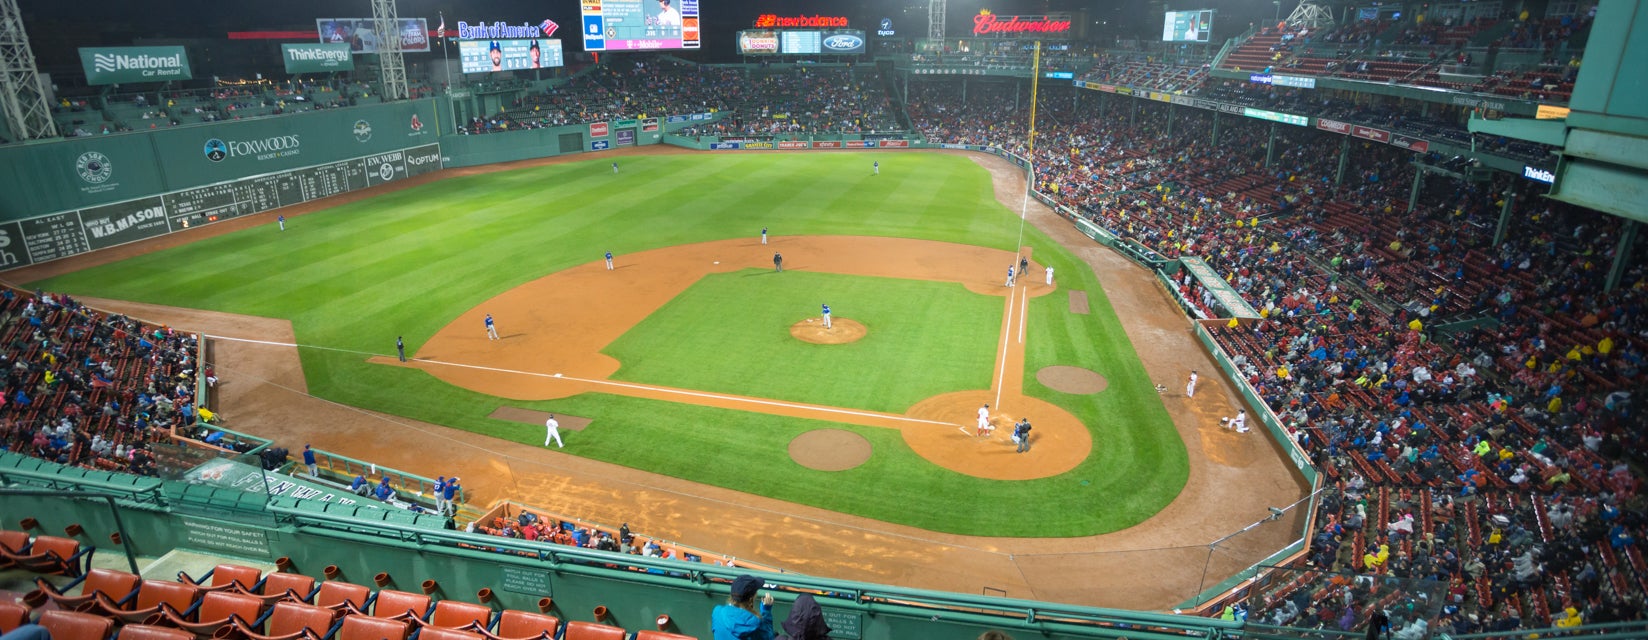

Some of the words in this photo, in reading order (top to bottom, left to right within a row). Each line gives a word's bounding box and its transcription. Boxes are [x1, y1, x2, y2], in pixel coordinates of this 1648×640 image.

[458, 21, 489, 38] Bank
[491, 22, 500, 38] of
[501, 22, 540, 38] America
[974, 14, 1070, 34] Budweiser
[831, 37, 855, 49] Ford
[288, 48, 349, 60] ThinkEnergy
[116, 54, 180, 69] National
[229, 135, 300, 157] FOXWOODS
[382, 153, 403, 163] WEBB
[415, 154, 439, 165] OPTUM
[81, 163, 111, 182] SCHOLARS
[1524, 166, 1555, 183] ThinkEn
[181, 188, 211, 197] FENWAY
[86, 219, 99, 228] WHO
[91, 206, 164, 238] W.B.MASON
[138, 222, 153, 230] SINCE
[183, 220, 189, 228] 2
[241, 530, 264, 538] SAFETY
